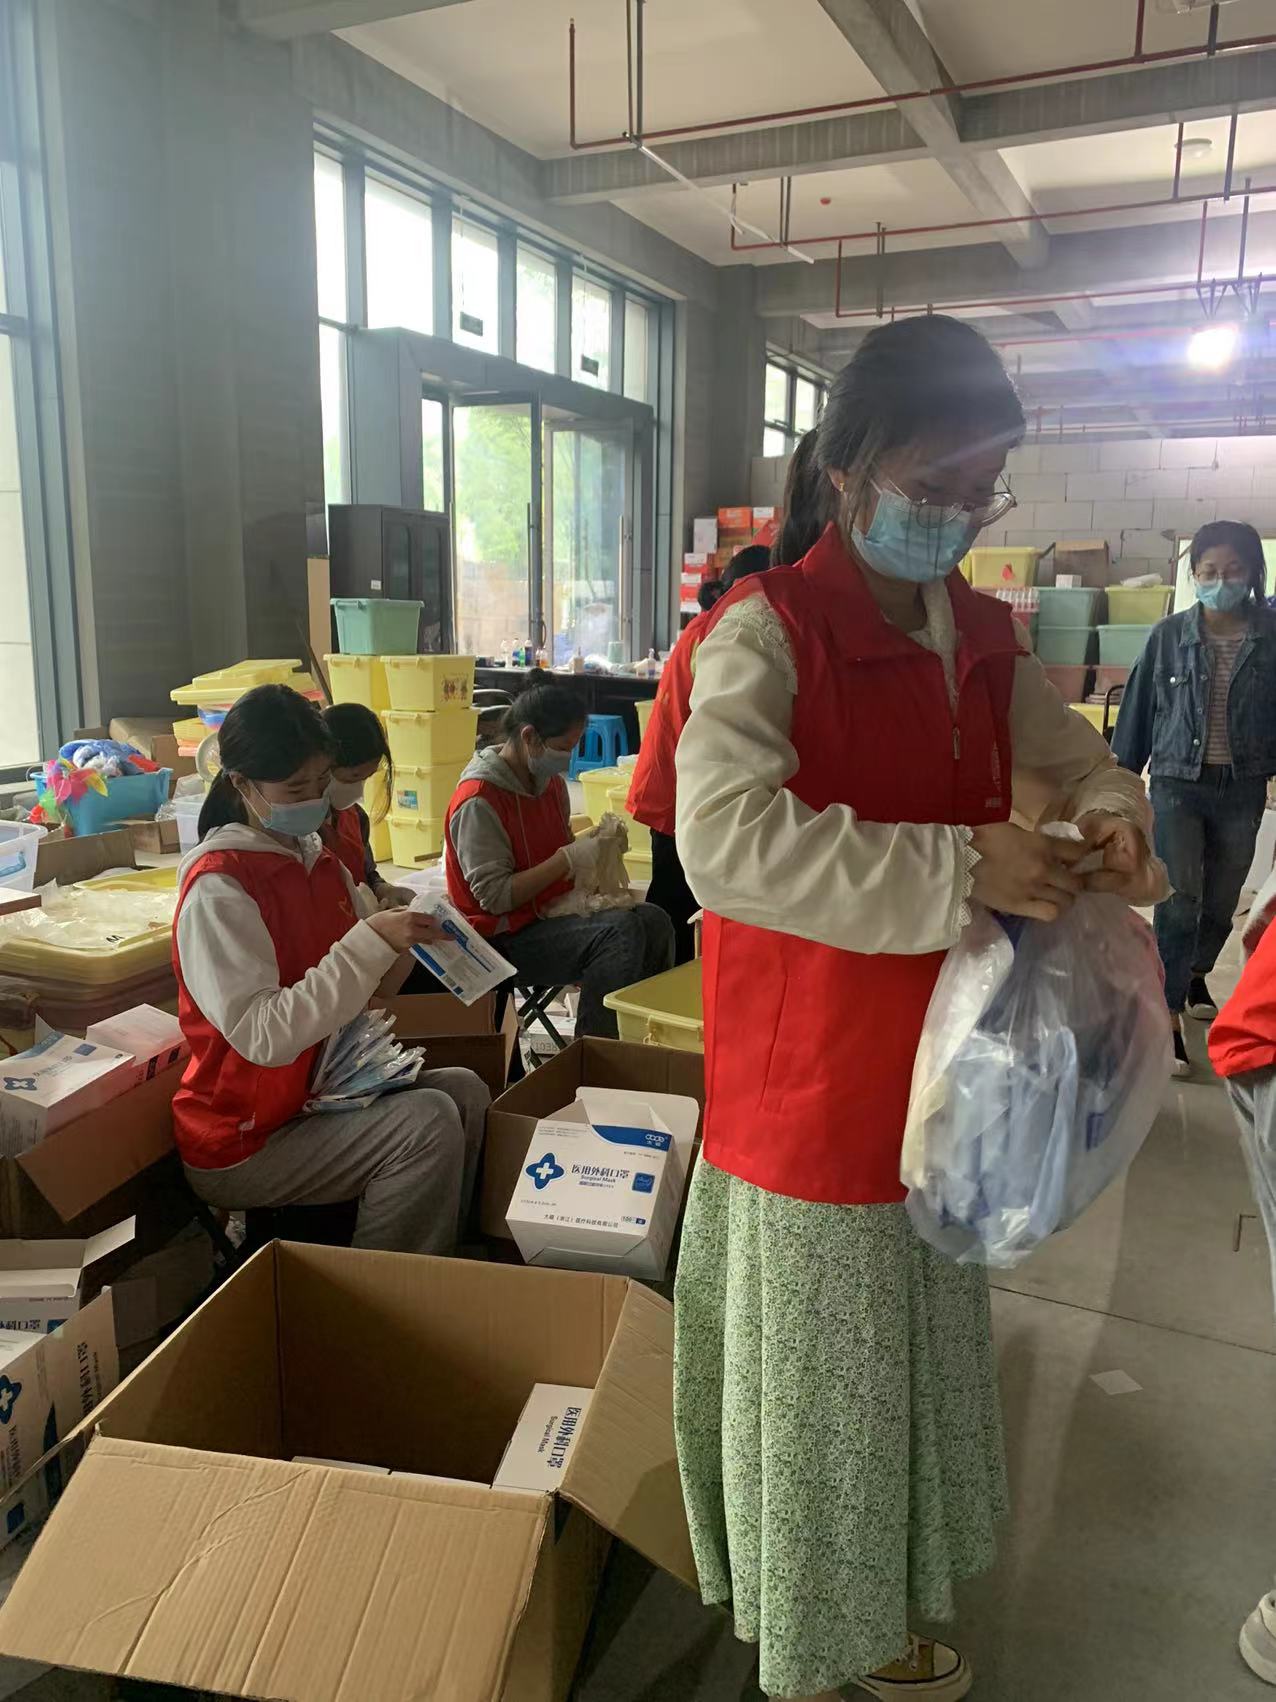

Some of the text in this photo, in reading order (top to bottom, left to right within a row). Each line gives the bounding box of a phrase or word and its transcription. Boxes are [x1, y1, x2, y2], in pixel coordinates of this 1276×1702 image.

[571, 1164, 630, 1179] 医用外科口罩
[538, 1416, 558, 1453] Surgical Mask
[547, 1407, 582, 1469] 医用外科口罩
